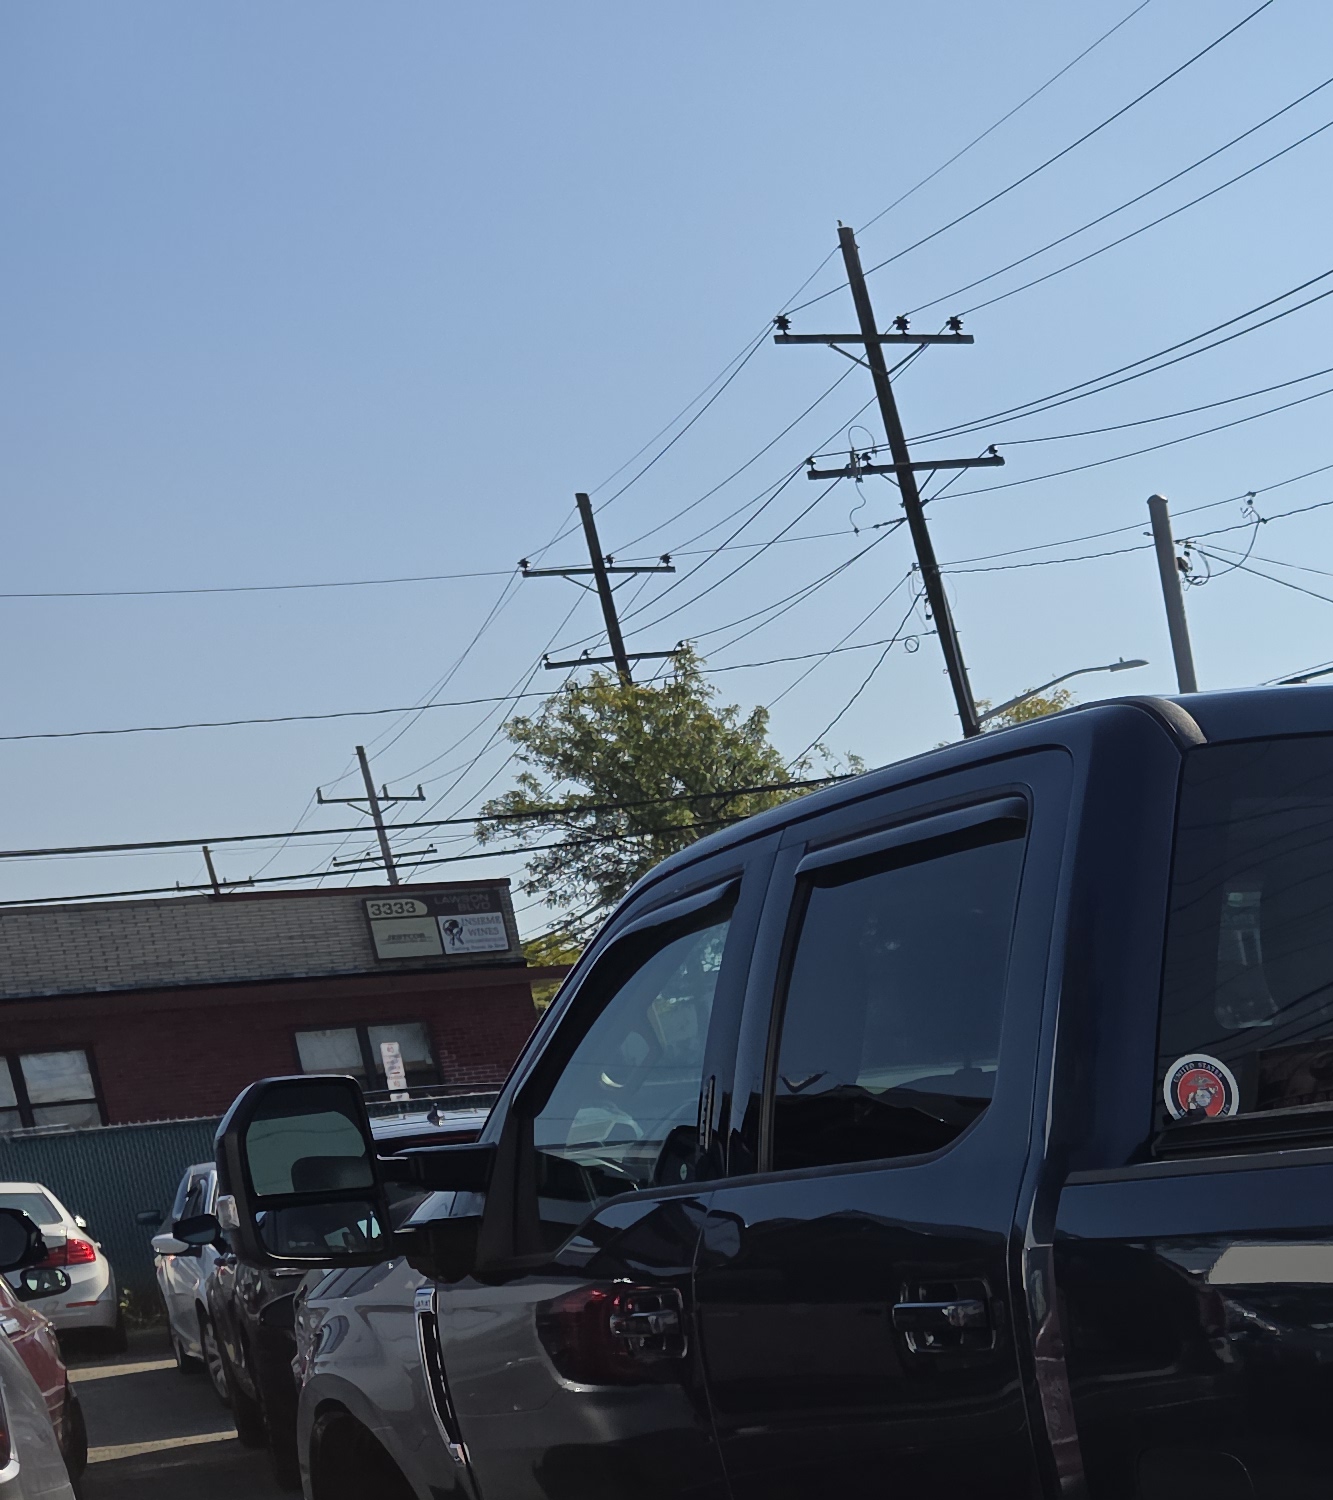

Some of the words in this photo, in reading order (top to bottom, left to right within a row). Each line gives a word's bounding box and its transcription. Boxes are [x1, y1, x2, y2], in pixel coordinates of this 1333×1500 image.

[434, 893, 489, 905] LAWSON
[370, 901, 417, 916] 3333
[457, 901, 491, 912] BLVD
[467, 927, 500, 937] WINES
[1173, 1062, 1195, 1083] UNITED
[1197, 1061, 1224, 1079] STATES
